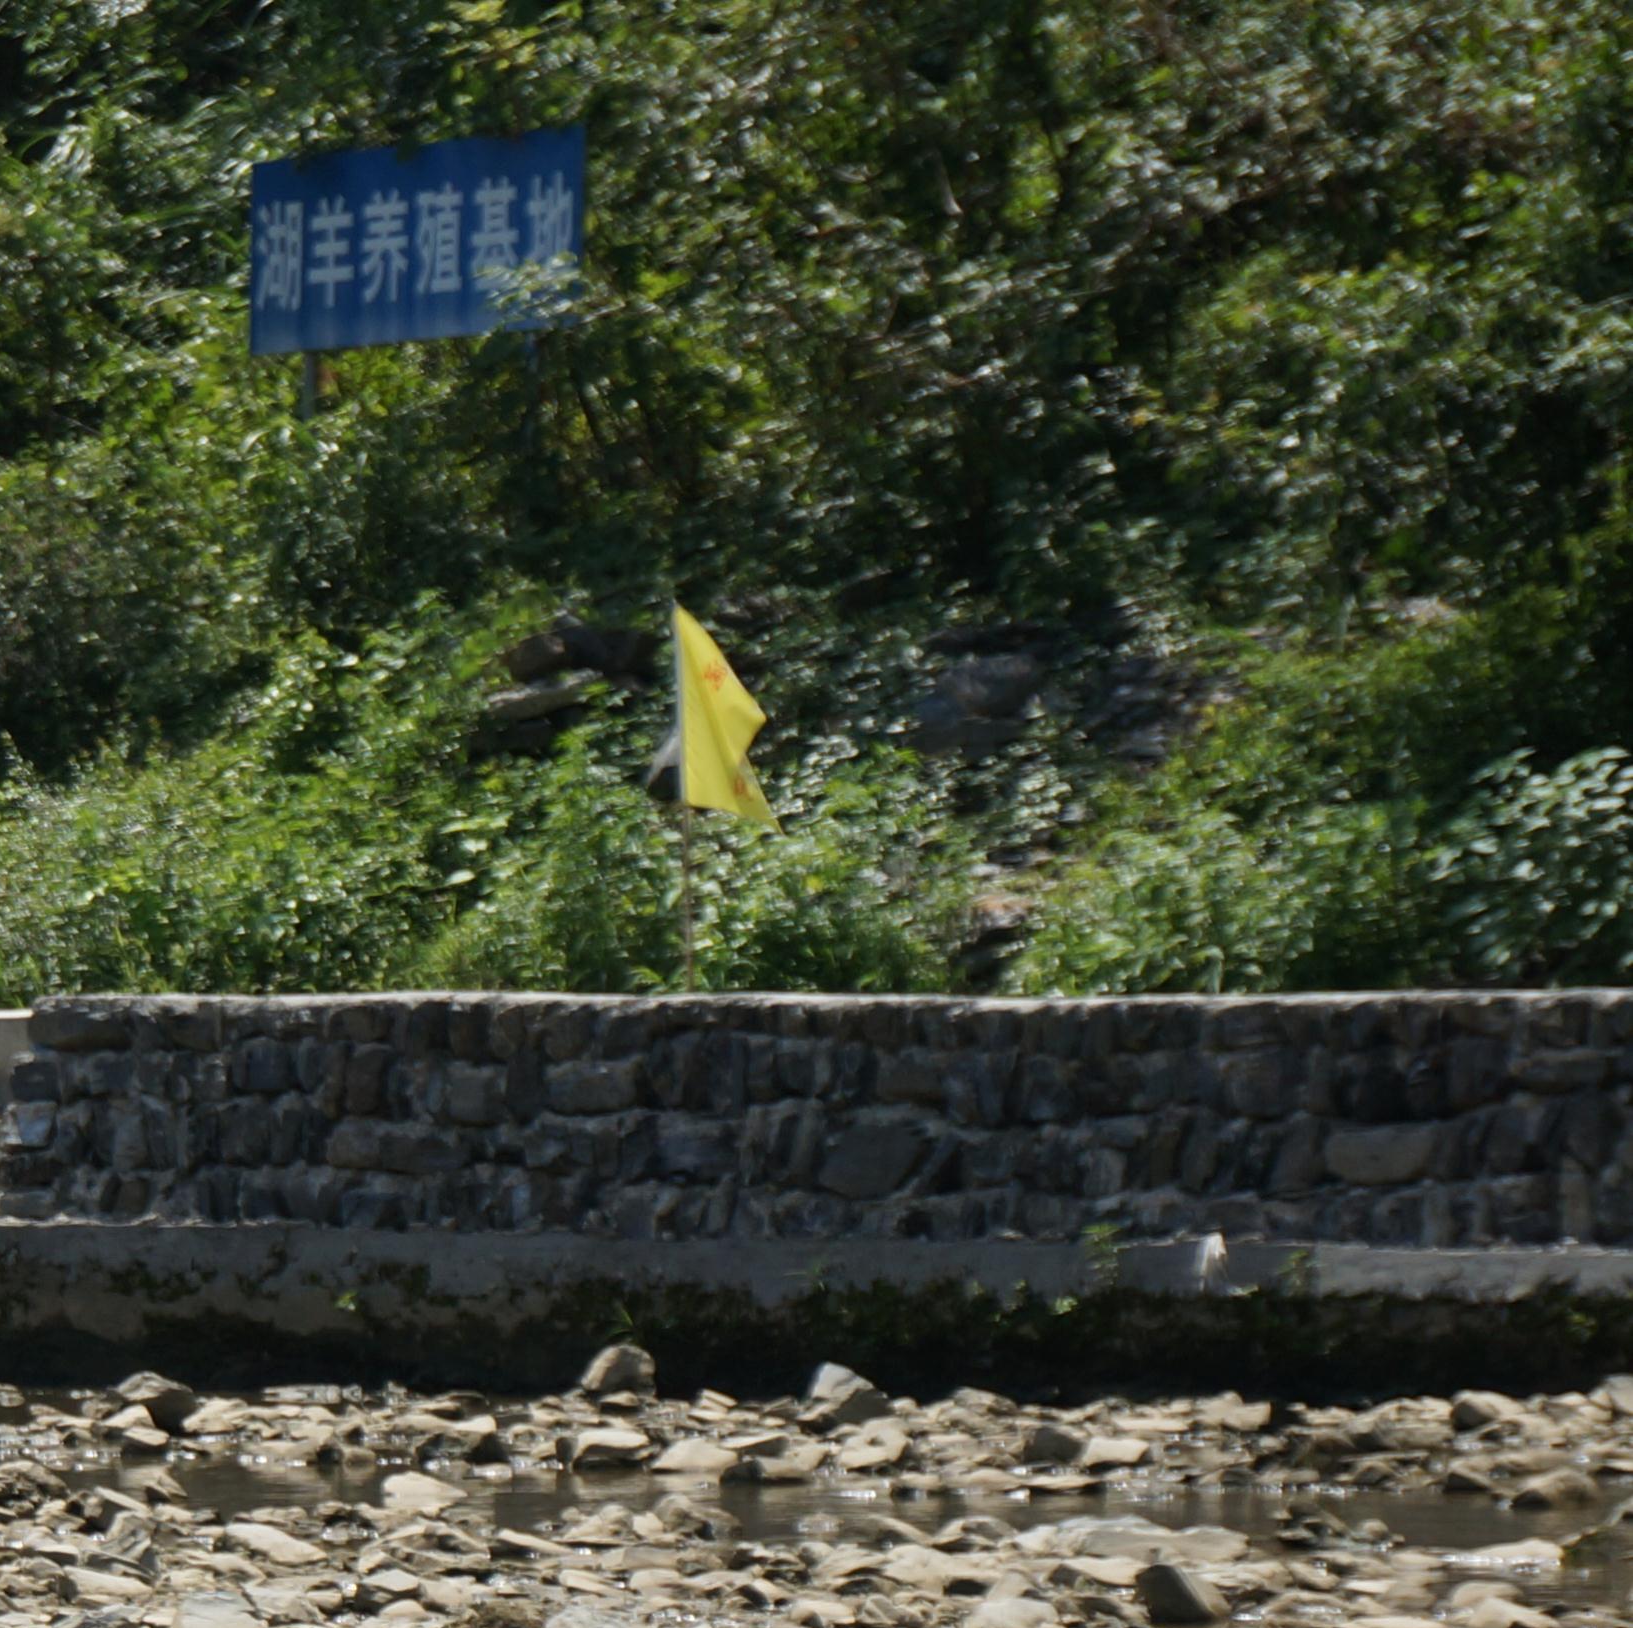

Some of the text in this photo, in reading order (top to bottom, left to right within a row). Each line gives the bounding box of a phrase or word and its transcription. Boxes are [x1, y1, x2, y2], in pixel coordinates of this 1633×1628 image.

[256, 169, 575, 312] 湖羊养殖基地
